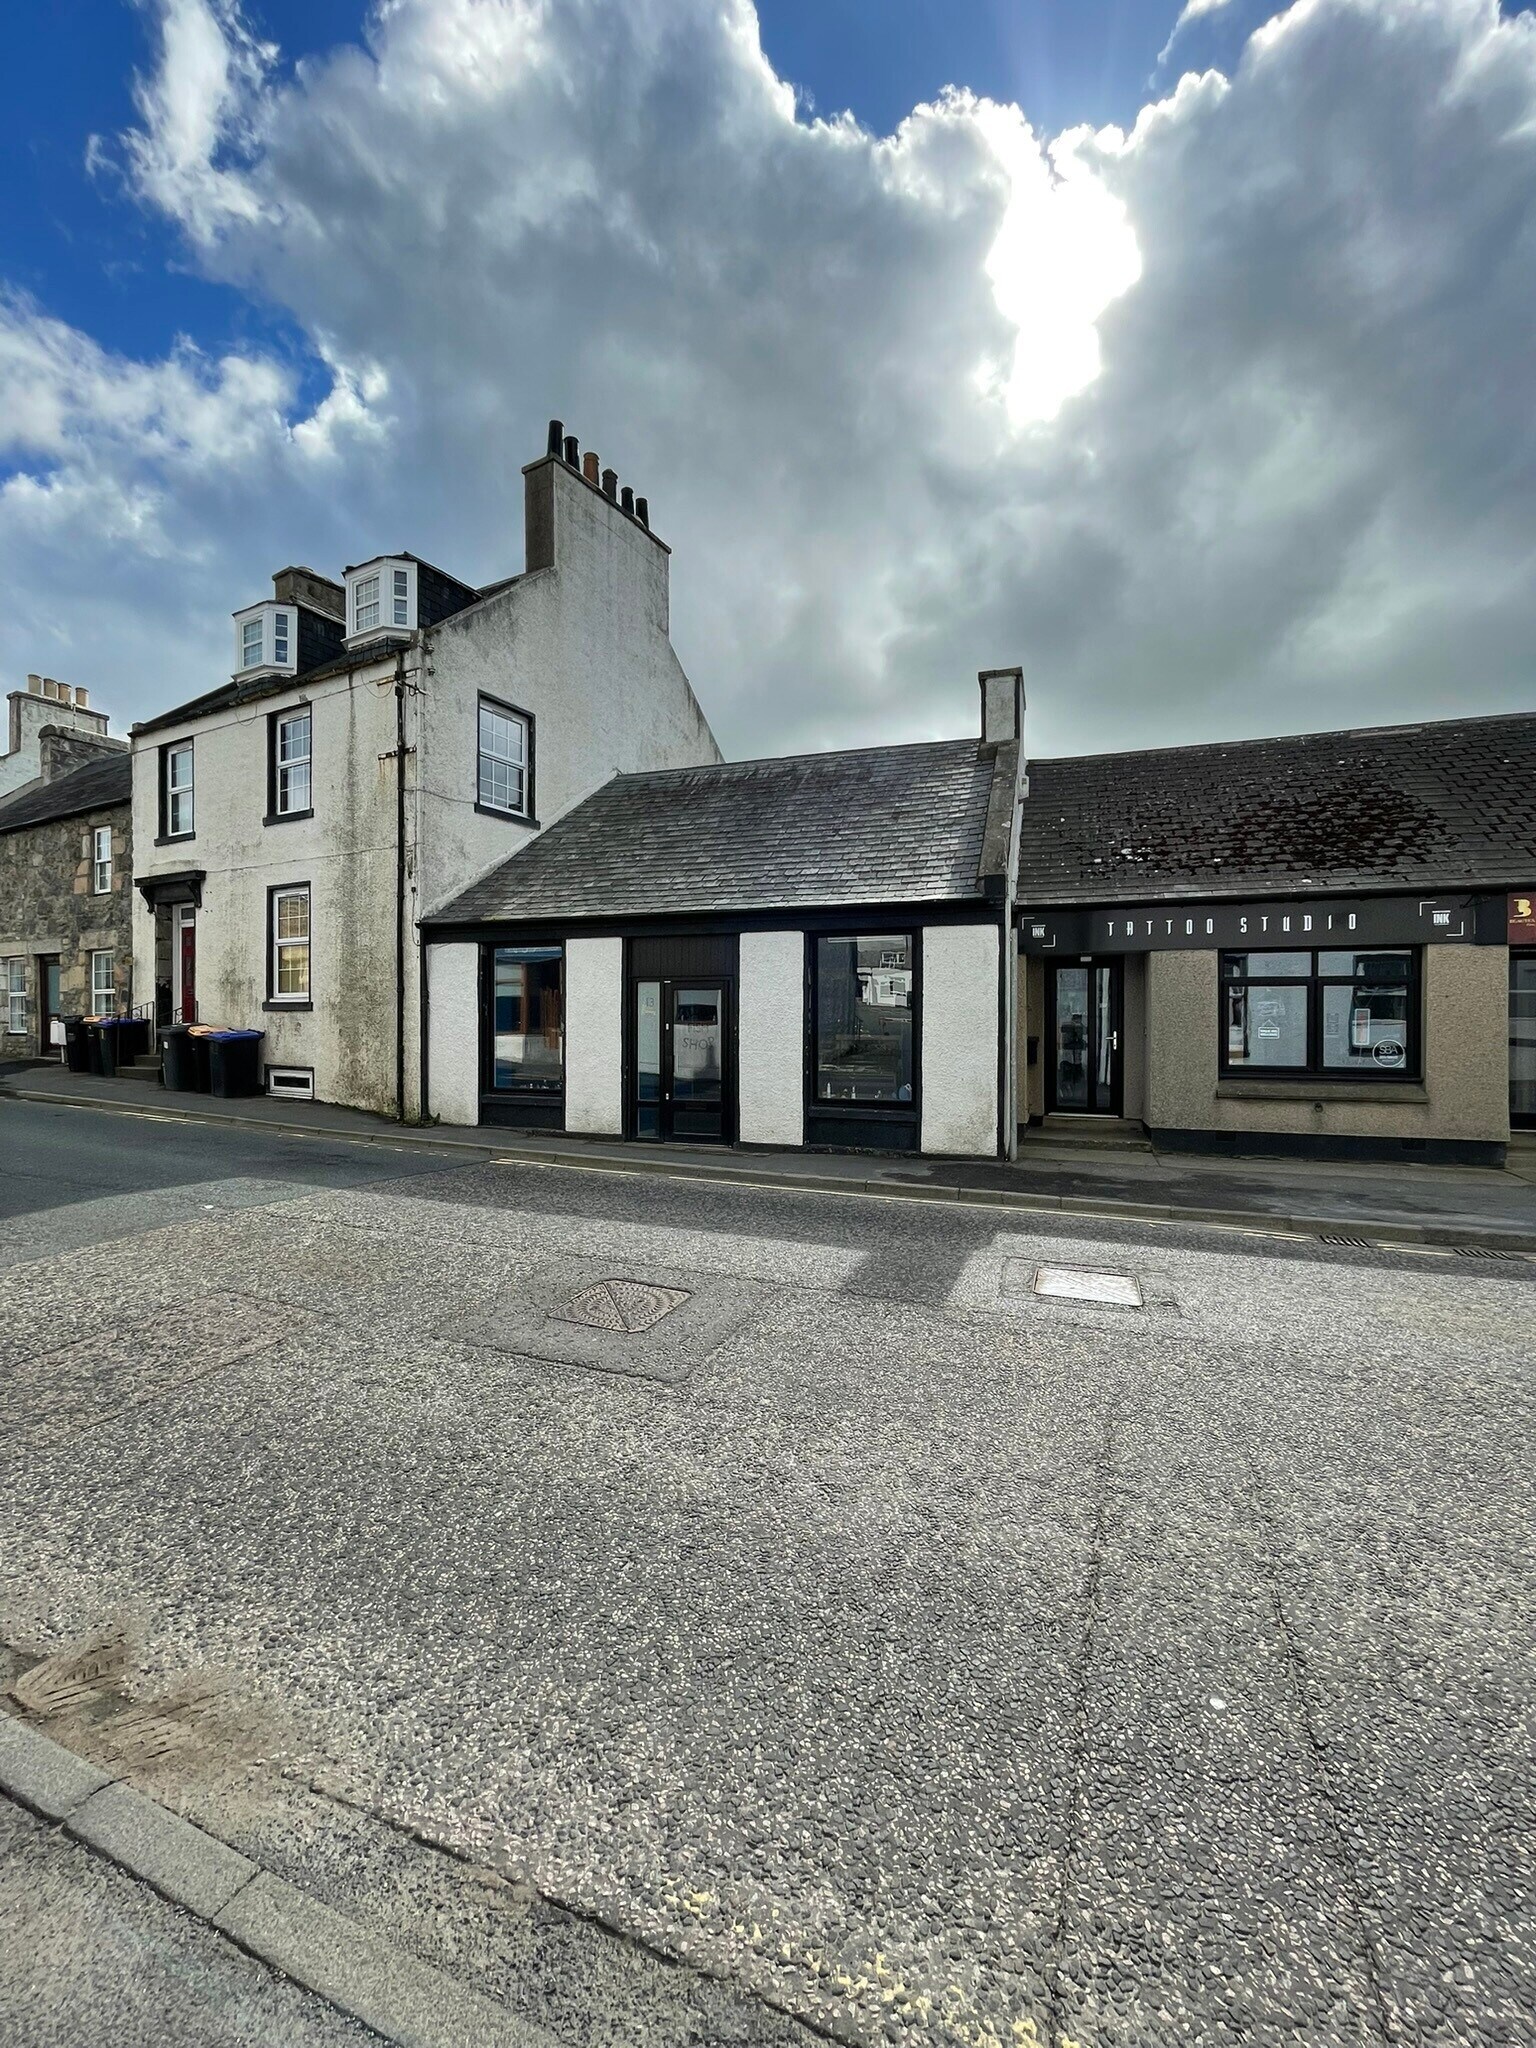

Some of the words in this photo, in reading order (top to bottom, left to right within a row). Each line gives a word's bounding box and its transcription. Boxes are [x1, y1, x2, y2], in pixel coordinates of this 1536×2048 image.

[1107, 918, 1214, 937] TATTOO
[1239, 913, 1357, 933] STUDIO
[1432, 912, 1450, 925] INK
[1032, 926, 1046, 938] INK
[682, 1036, 715, 1050] SHOP
[1379, 1045, 1398, 1055] SBA
